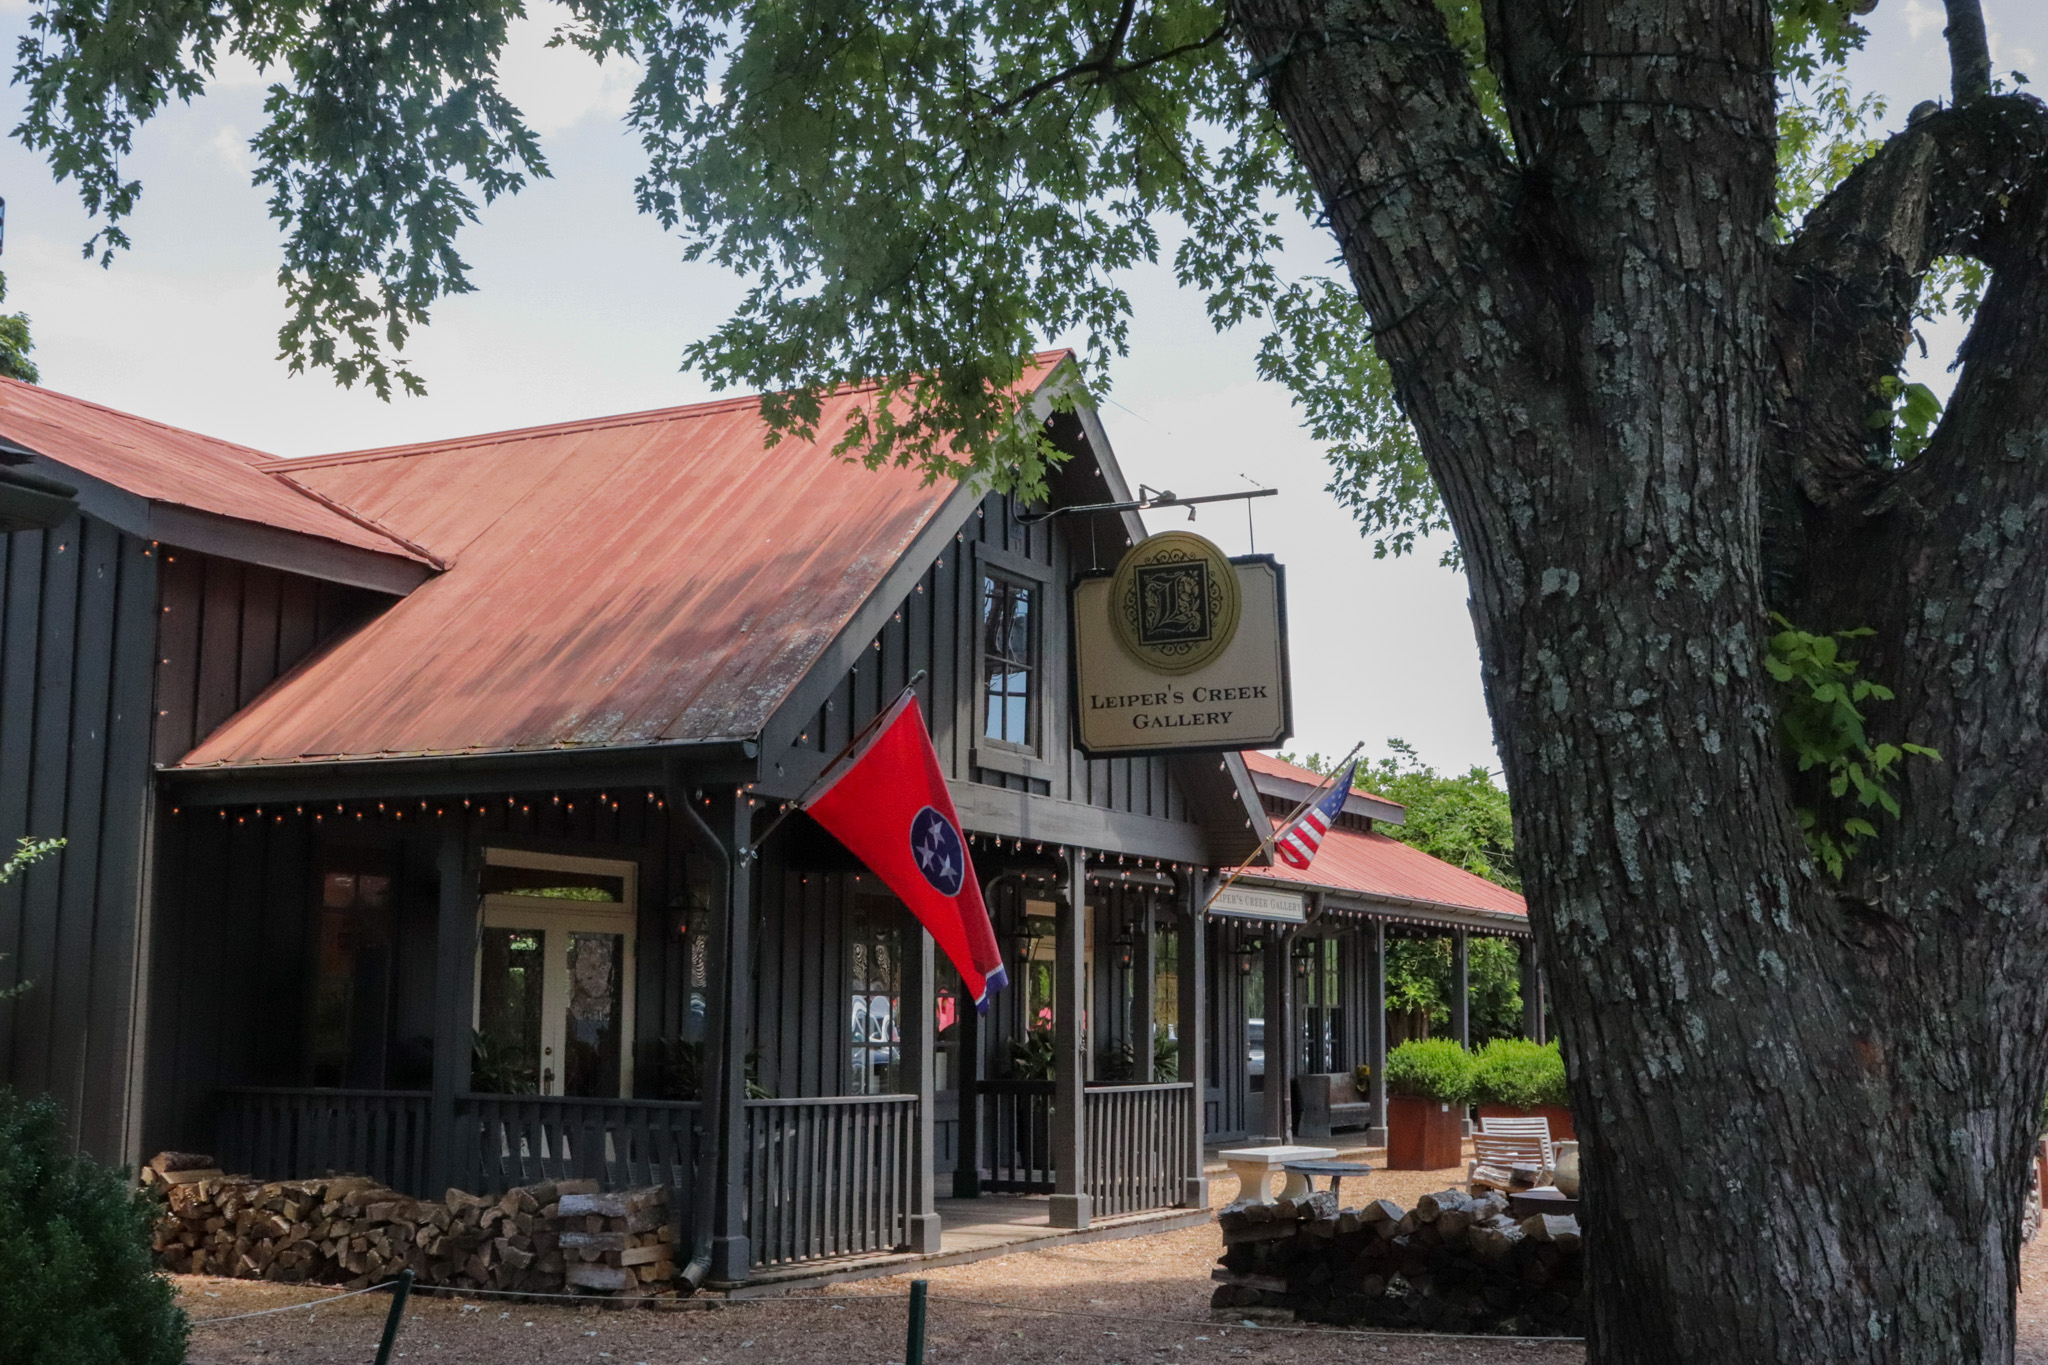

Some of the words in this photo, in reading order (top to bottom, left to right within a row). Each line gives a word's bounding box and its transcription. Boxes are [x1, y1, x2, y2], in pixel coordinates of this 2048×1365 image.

[1091, 684, 1184, 709] LEIPER'S
[1192, 686, 1268, 704] CREEK
[1133, 711, 1233, 729] GALLERY
[1215, 893, 1243, 905] IPER'S
[1245, 895, 1268, 908] CREEK
[1271, 898, 1302, 912] GALLERY
